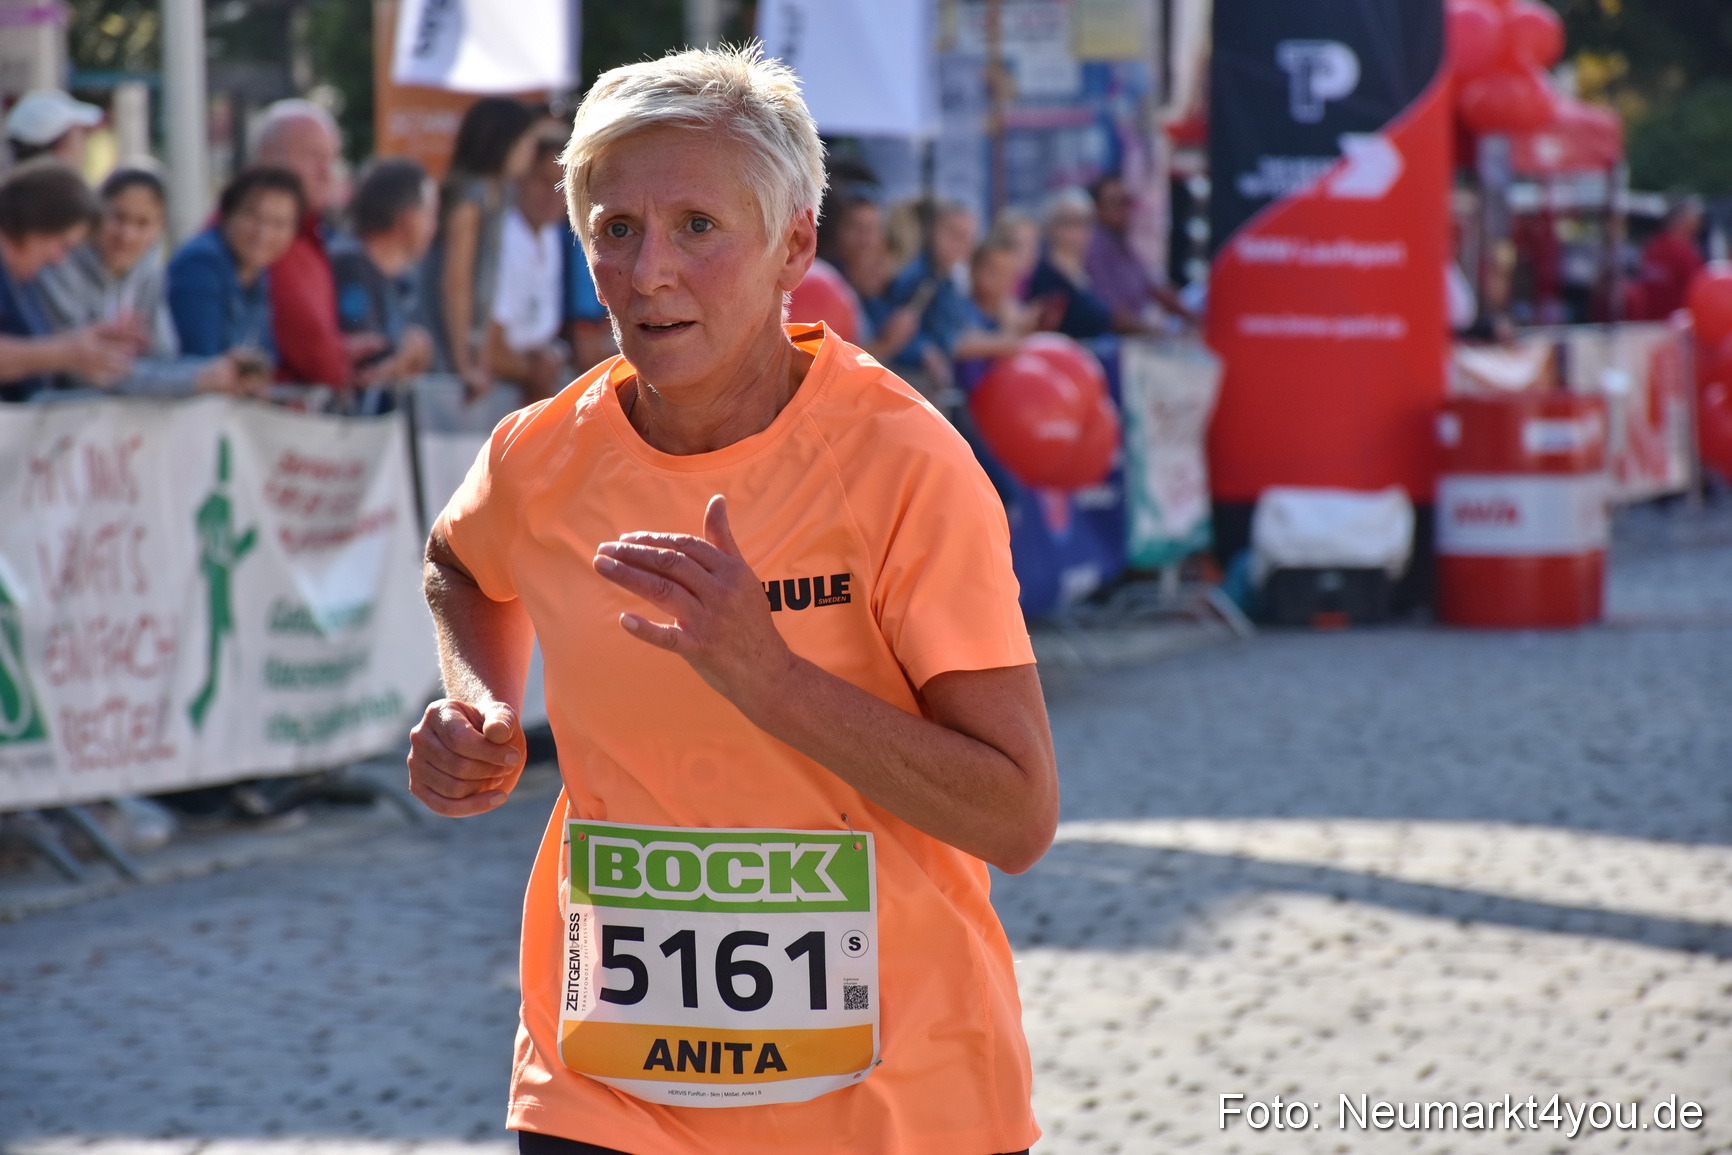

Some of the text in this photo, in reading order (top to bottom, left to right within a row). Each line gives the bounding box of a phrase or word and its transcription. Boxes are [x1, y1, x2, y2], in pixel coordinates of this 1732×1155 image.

[818, 596, 847, 605] SWEDEN
[590, 838, 846, 900] BOCK
[848, 936, 862, 952] S
[599, 924, 828, 1012] 5161
[643, 1038, 788, 1075] ANITA
